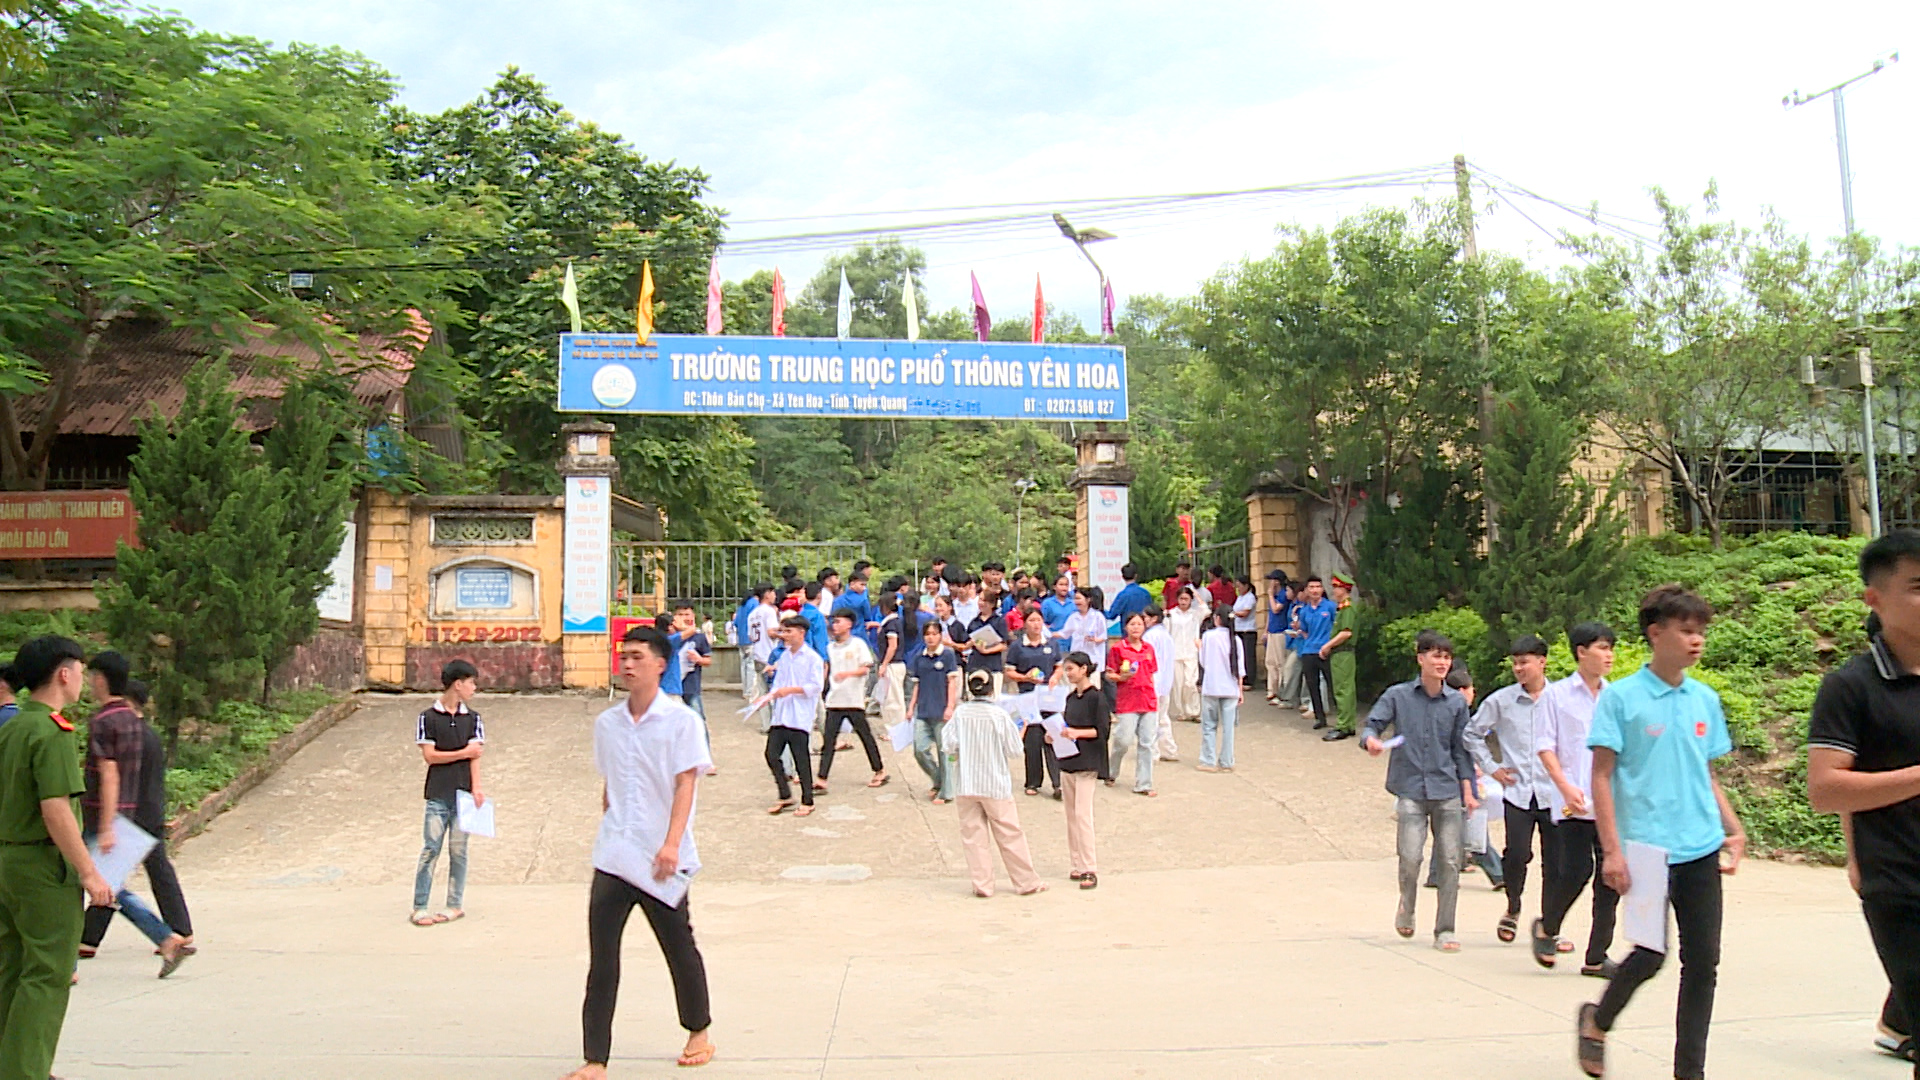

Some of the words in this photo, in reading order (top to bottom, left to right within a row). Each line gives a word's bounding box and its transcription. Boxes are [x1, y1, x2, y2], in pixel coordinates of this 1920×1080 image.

[670, 345, 761, 382] TRƯỜNG
[768, 355, 843, 383] TRUNG
[850, 357, 895, 390] HỌC
[901, 348, 948, 386] PHỔ
[951, 354, 1024, 388] THÔNG
[1028, 355, 1070, 388] YÊN
[1077, 362, 1120, 390] HOA
[806, 393, 824, 409] Hoa
[64, 500, 98, 518] THANH
[100, 497, 124, 517] NIÊN
